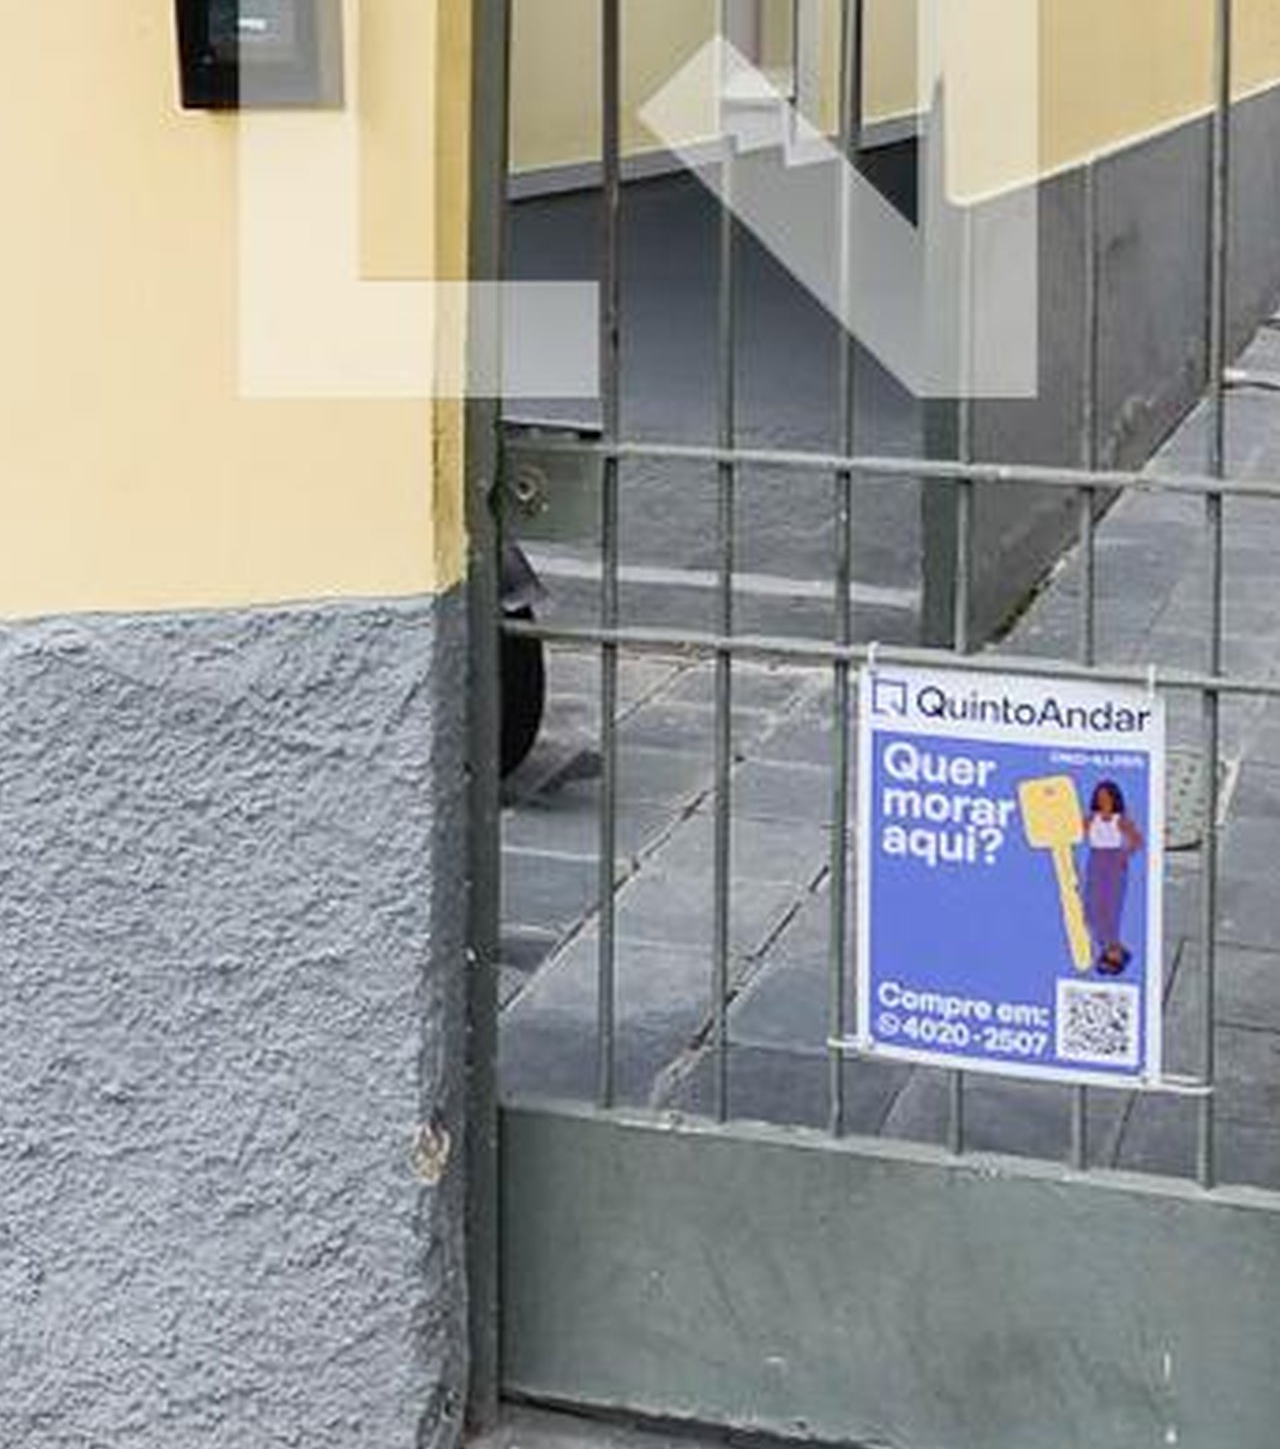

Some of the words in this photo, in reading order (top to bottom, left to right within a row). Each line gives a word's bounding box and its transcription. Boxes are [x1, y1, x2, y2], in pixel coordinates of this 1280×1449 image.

[917, 685, 1151, 733] QuintoAndar
[883, 741, 996, 787] Quer
[882, 786, 1015, 828] morar
[882, 824, 1004, 867] aqui?
[996, 1003, 1050, 1027] em:
